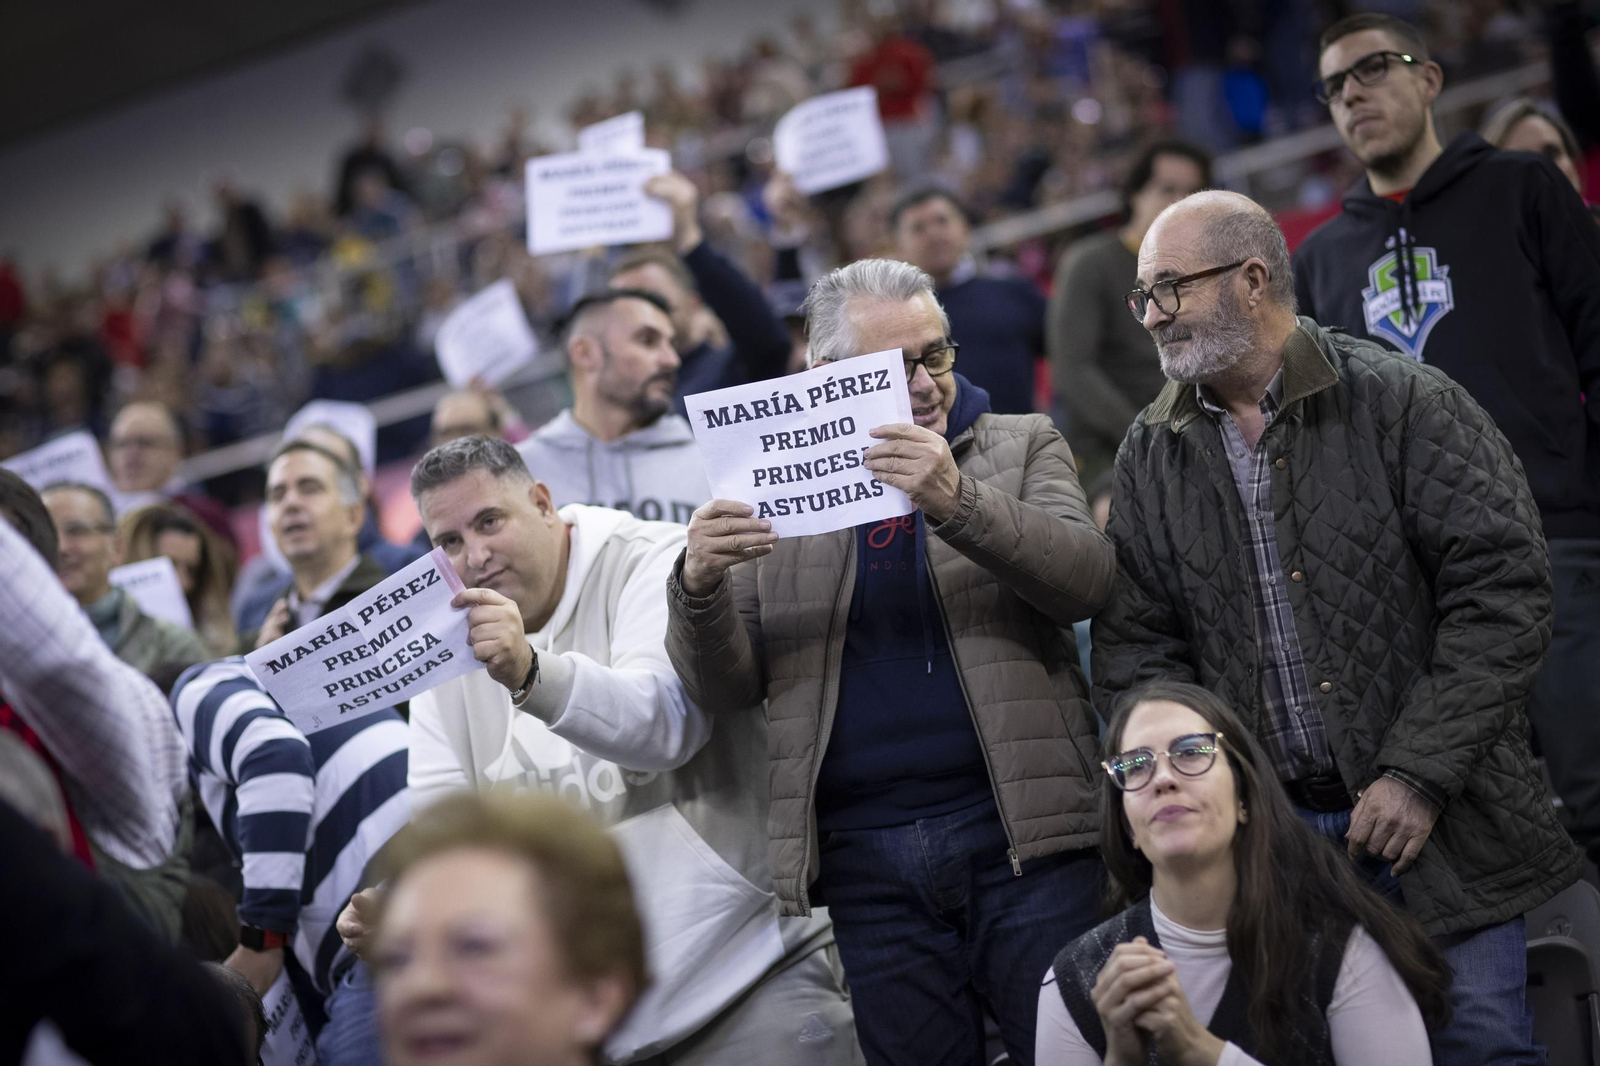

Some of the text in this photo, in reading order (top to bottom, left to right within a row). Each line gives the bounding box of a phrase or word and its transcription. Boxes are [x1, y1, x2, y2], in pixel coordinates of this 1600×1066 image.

[704, 369, 891, 428] MARÍA PÉREZ
[760, 416, 856, 452] PREMIO
[758, 478, 884, 519] ASTURIAS
[267, 568, 441, 675] MARÍA PÉREZ
[322, 614, 413, 672] PREMIO
[323, 632, 441, 698] PRINCESA
[338, 648, 454, 714] ASTURIAS
